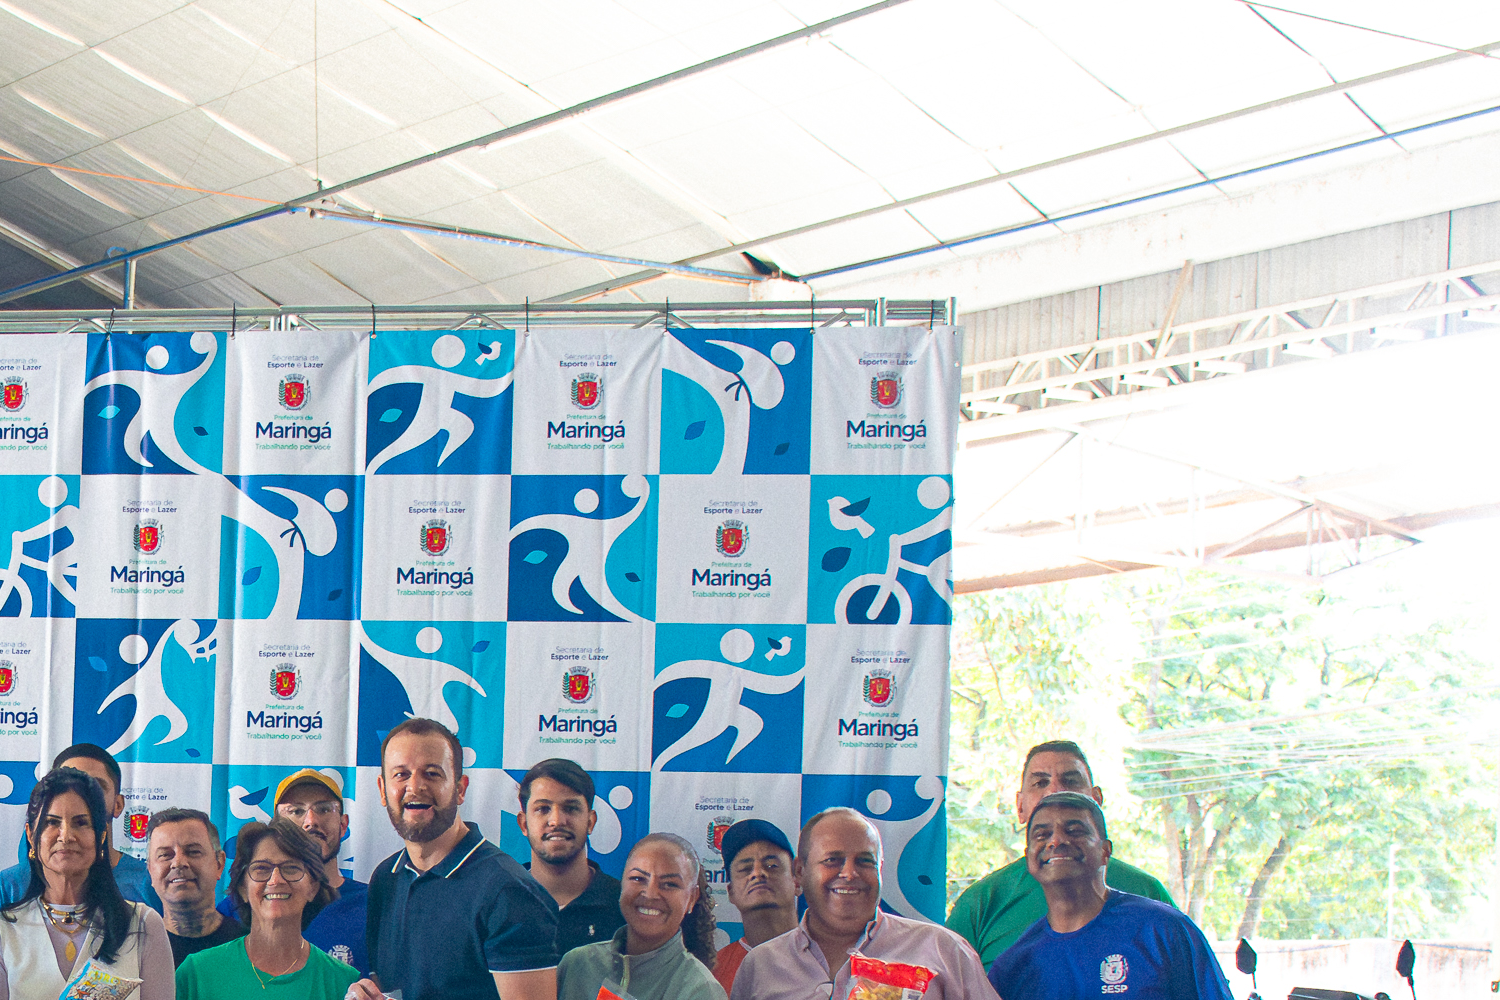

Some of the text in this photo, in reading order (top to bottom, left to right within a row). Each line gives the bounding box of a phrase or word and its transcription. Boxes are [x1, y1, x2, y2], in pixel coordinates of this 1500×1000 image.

[256, 421, 331, 442] Maringá
[547, 420, 625, 442] Maringá
[846, 418, 927, 441] Maringá
[591, 444, 605, 452] por
[110, 564, 185, 585] Maringá
[397, 567, 473, 589] Maringá
[692, 567, 770, 589] Maringá
[247, 710, 322, 731] Maringá
[538, 714, 617, 736] Maringá
[838, 718, 918, 741] Maringá
[538, 736, 616, 746] Trabalhando por você
[695, 803, 724, 812] Esporte
[1101, 985, 1128, 994] SESP
